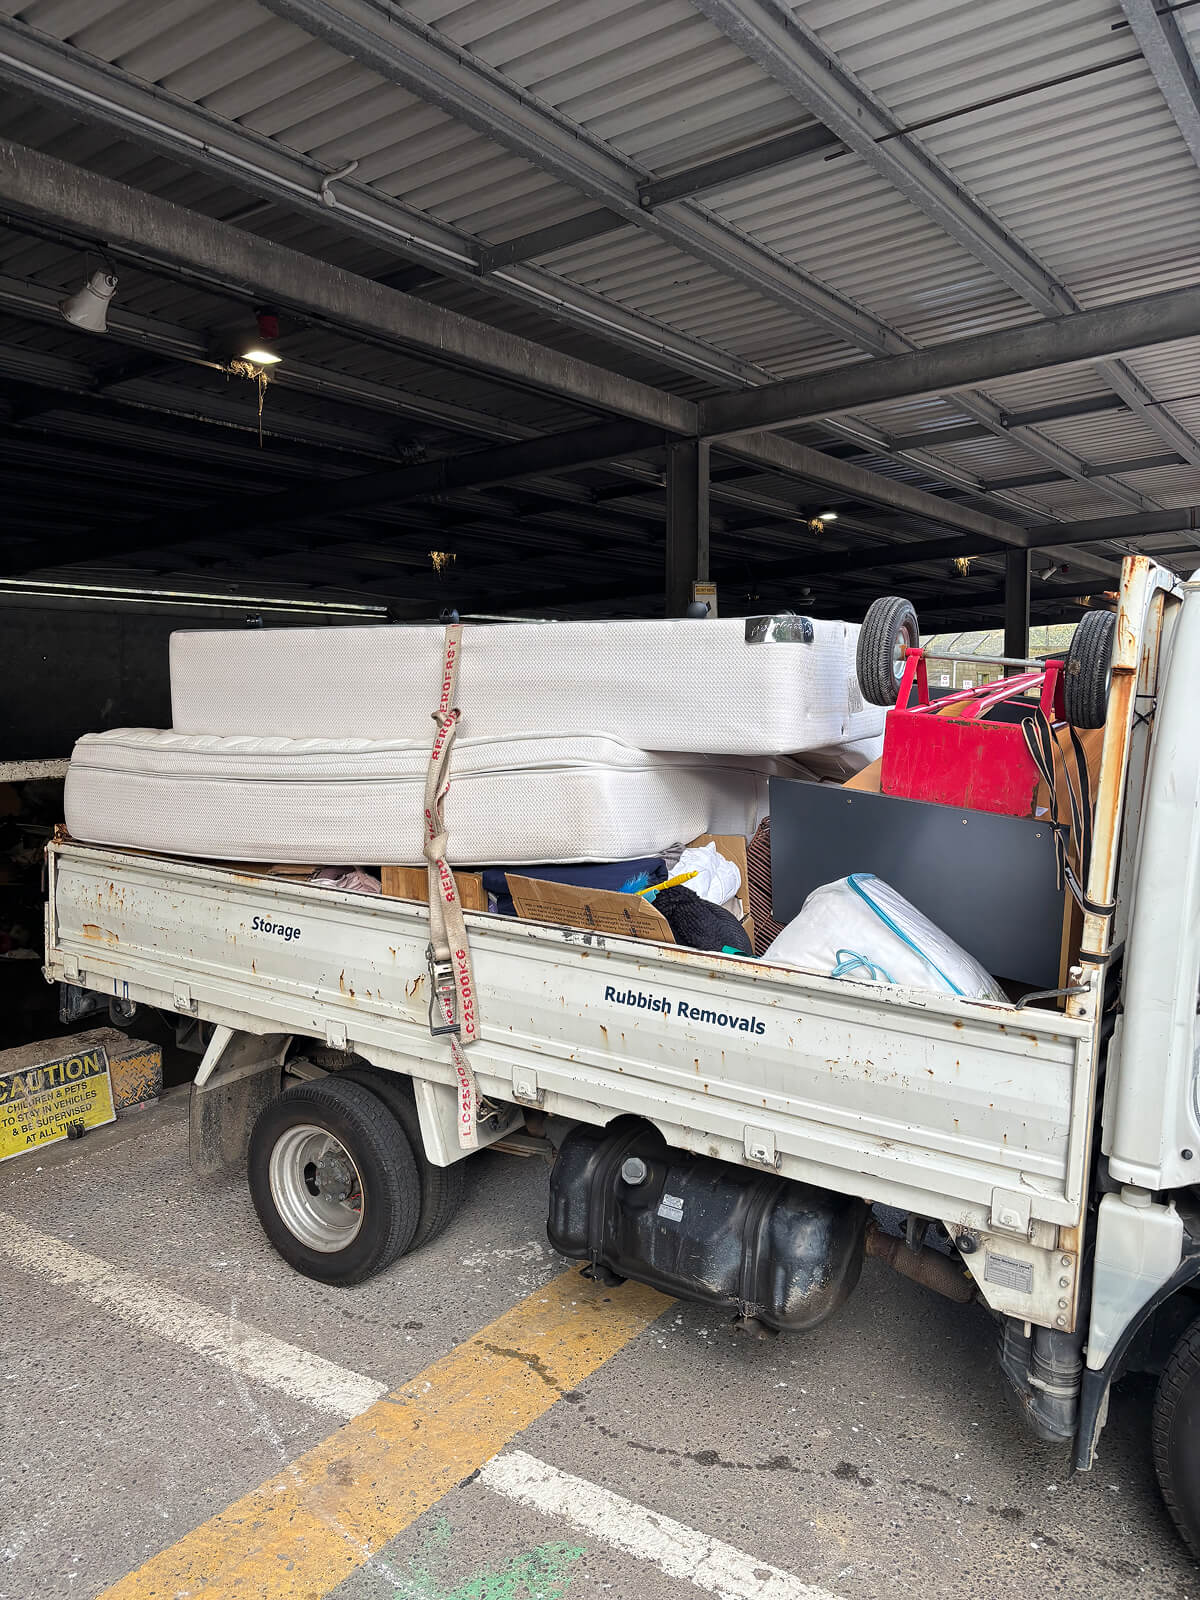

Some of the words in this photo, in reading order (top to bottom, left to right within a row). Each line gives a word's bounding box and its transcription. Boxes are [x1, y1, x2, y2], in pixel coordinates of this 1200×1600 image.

[251, 916, 301, 941] Storage
[456, 949, 475, 1039] C2500KG
[604, 985, 672, 1014] Rubbish
[677, 1001, 766, 1035] Removals
[56, 1090, 63, 1098] &
[64, 1081, 87, 1096] PETS
[2, 1117, 15, 1127] TO
[17, 1108, 40, 1122] STAY
[42, 1104, 52, 1115] IN
[54, 1090, 97, 1109] VEHICLES
[12, 1128, 19, 1136] &
[21, 1123, 33, 1133] BE
[36, 1103, 92, 1128] SUPERVISED
[26, 1134, 36, 1144] AT
[40, 1127, 56, 1139] ALL
[56, 1117, 85, 1132] TIMES
